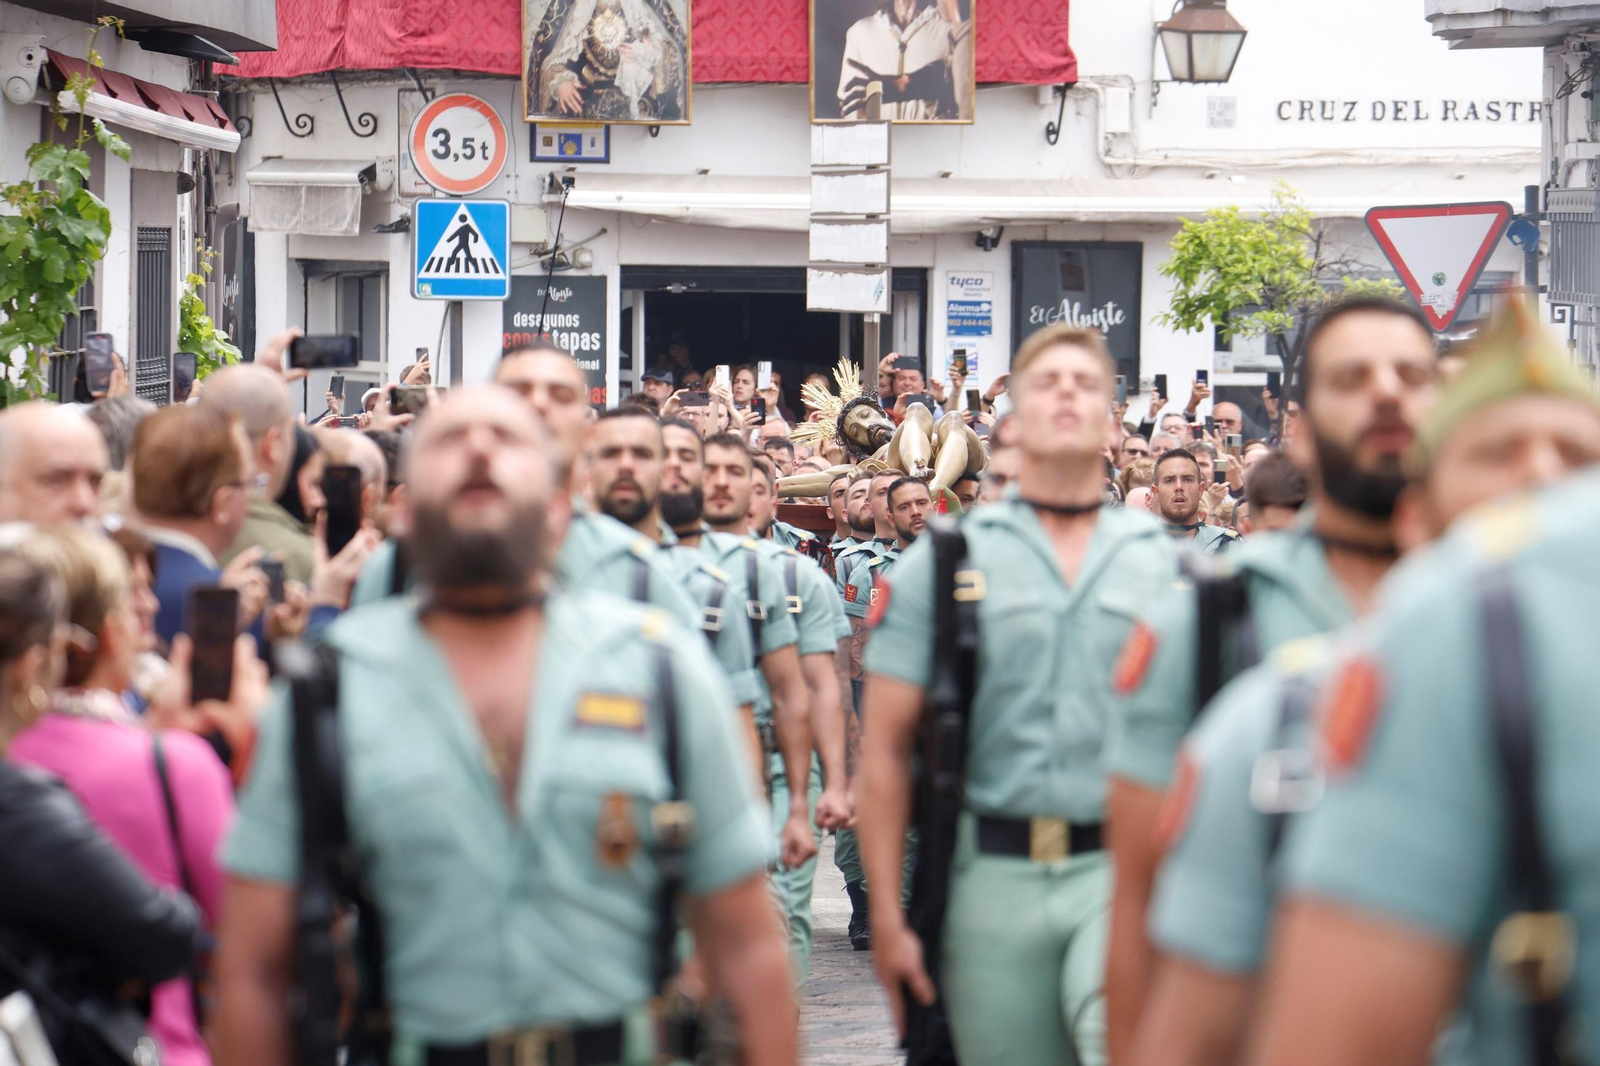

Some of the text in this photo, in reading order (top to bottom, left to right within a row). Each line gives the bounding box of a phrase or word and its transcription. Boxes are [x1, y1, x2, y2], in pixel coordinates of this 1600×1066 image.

[1276, 100, 1358, 121] CRUZ
[1371, 100, 1429, 121] DEL
[949, 276, 983, 288] tyco
[948, 303, 980, 312] Alarma
[1029, 298, 1126, 333] El Alpiste
[513, 312, 580, 331] desayunos
[552, 329, 601, 356] tapas
